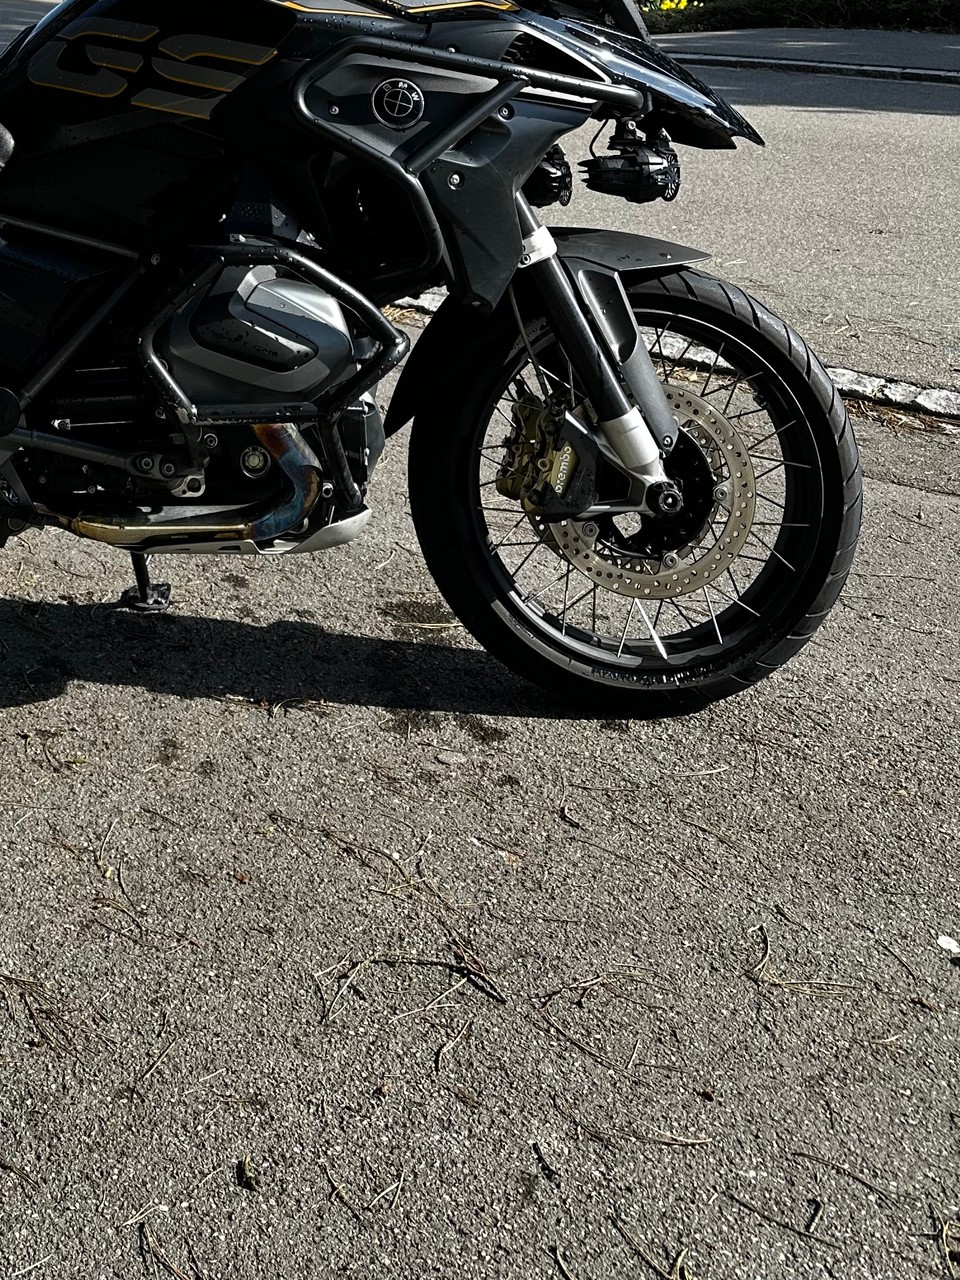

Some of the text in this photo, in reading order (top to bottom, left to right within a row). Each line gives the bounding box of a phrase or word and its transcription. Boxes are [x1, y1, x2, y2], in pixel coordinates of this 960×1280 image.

[26, 16, 279, 121] GS
[382, 81, 421, 101] BMW
[554, 445, 572, 494] brembo
